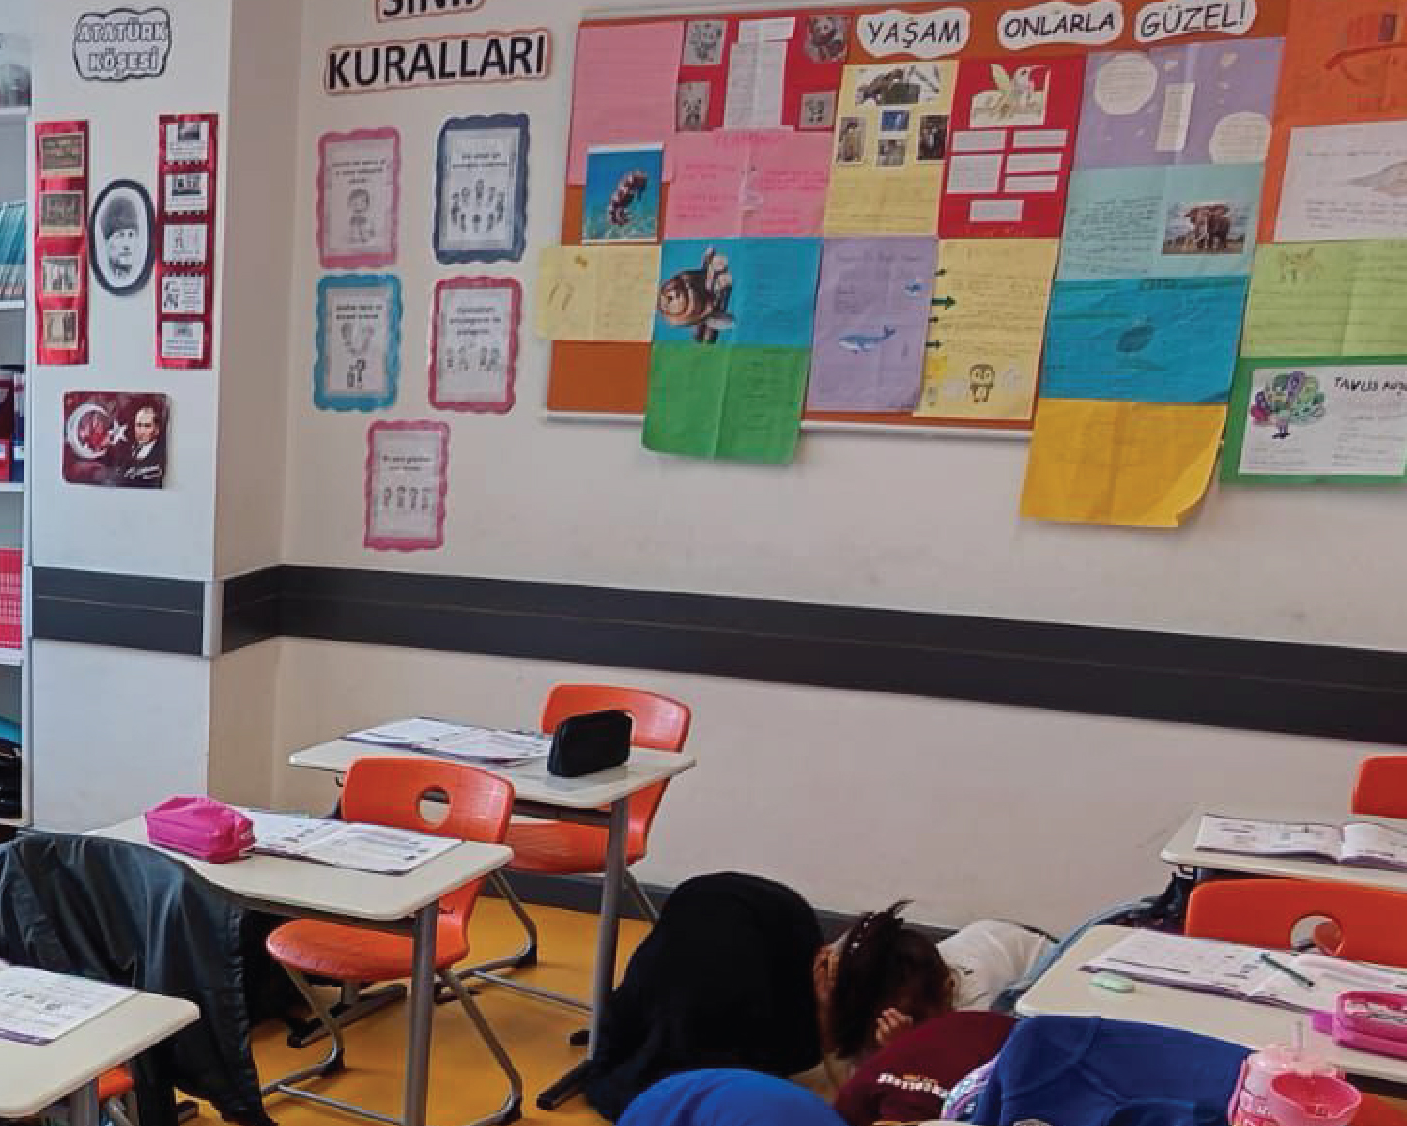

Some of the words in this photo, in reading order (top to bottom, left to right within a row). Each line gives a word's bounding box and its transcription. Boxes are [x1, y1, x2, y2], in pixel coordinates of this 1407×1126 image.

[75, 17, 168, 42] ATATÜRK
[867, 20, 961, 49] YAŞAM
[1004, 12, 1116, 38] ONLARLA
[1140, 1, 1246, 38] GÜZEL!
[88, 46, 160, 77] KÖŞESİ
[329, 34, 546, 90] KURALLARI
